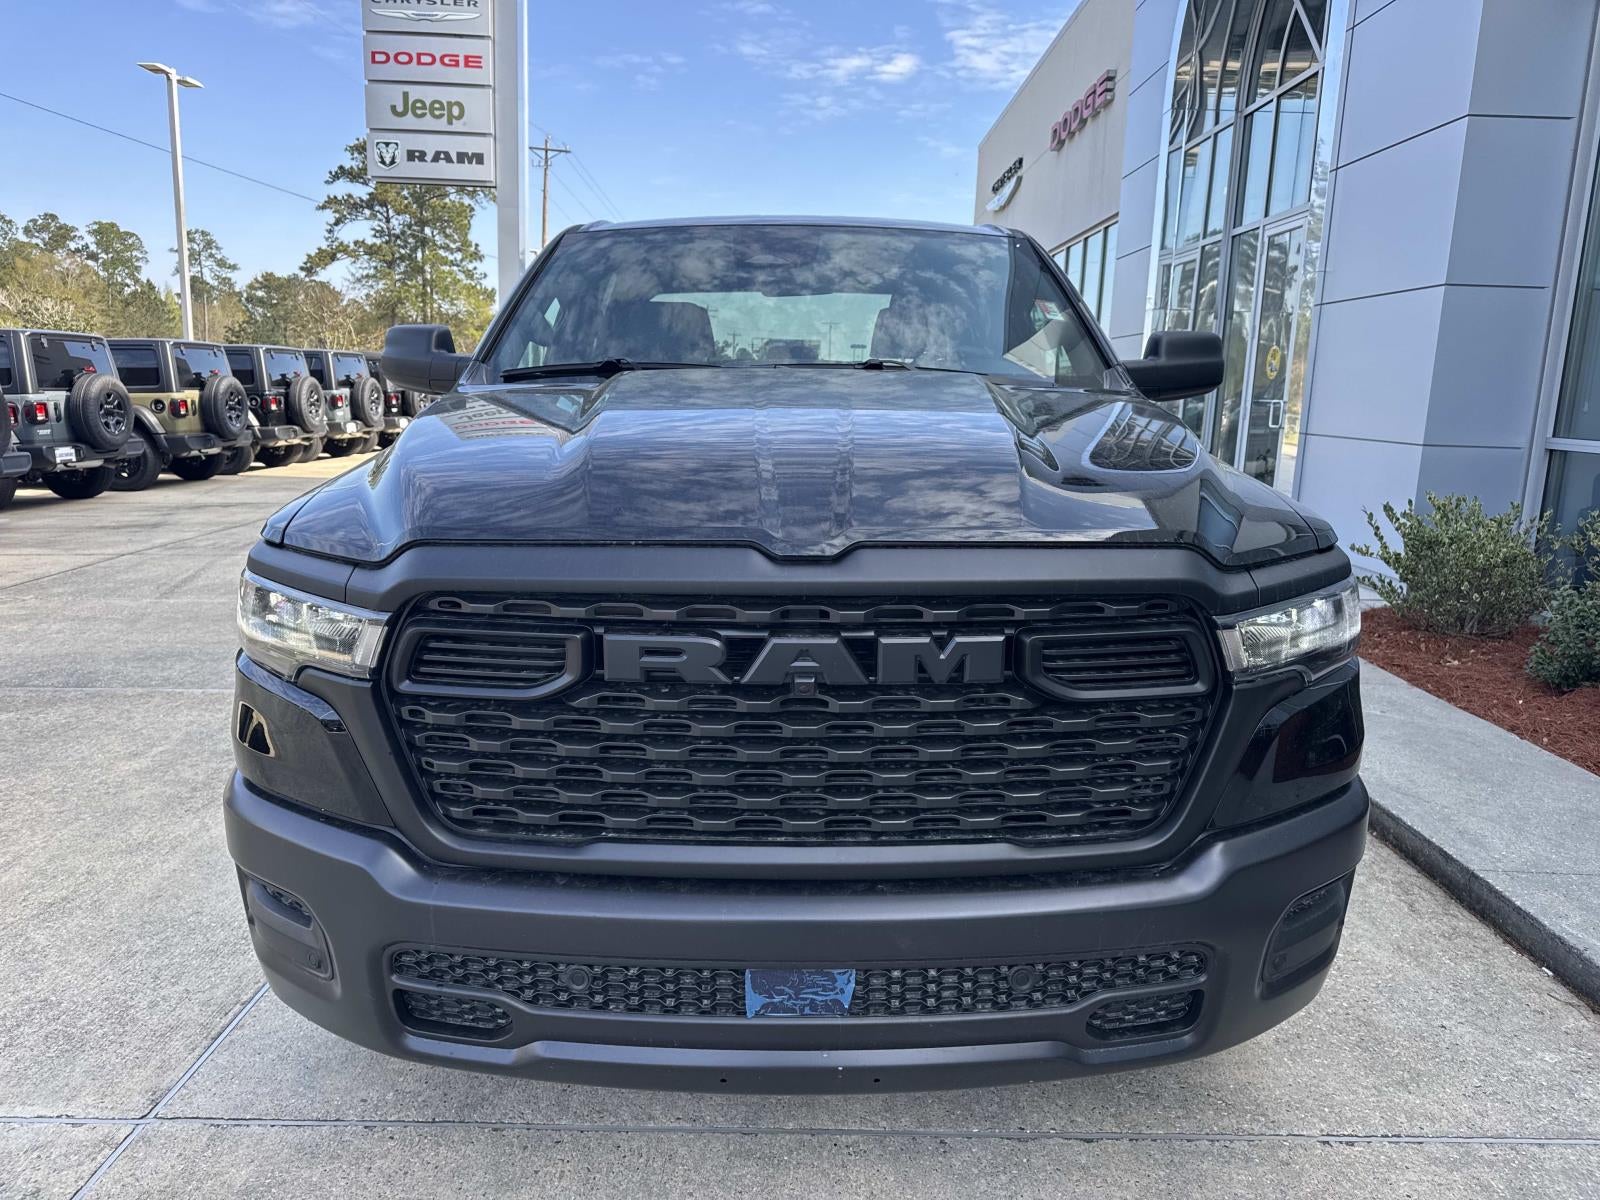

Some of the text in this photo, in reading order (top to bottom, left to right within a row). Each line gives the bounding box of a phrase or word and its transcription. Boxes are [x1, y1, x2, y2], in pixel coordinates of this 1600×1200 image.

[371, 51, 483, 69] DODGE
[390, 91, 465, 125] Jeep
[1050, 69, 1117, 151] DODGE
[406, 149, 484, 165] RAM
[604, 632, 1005, 684] RAM
